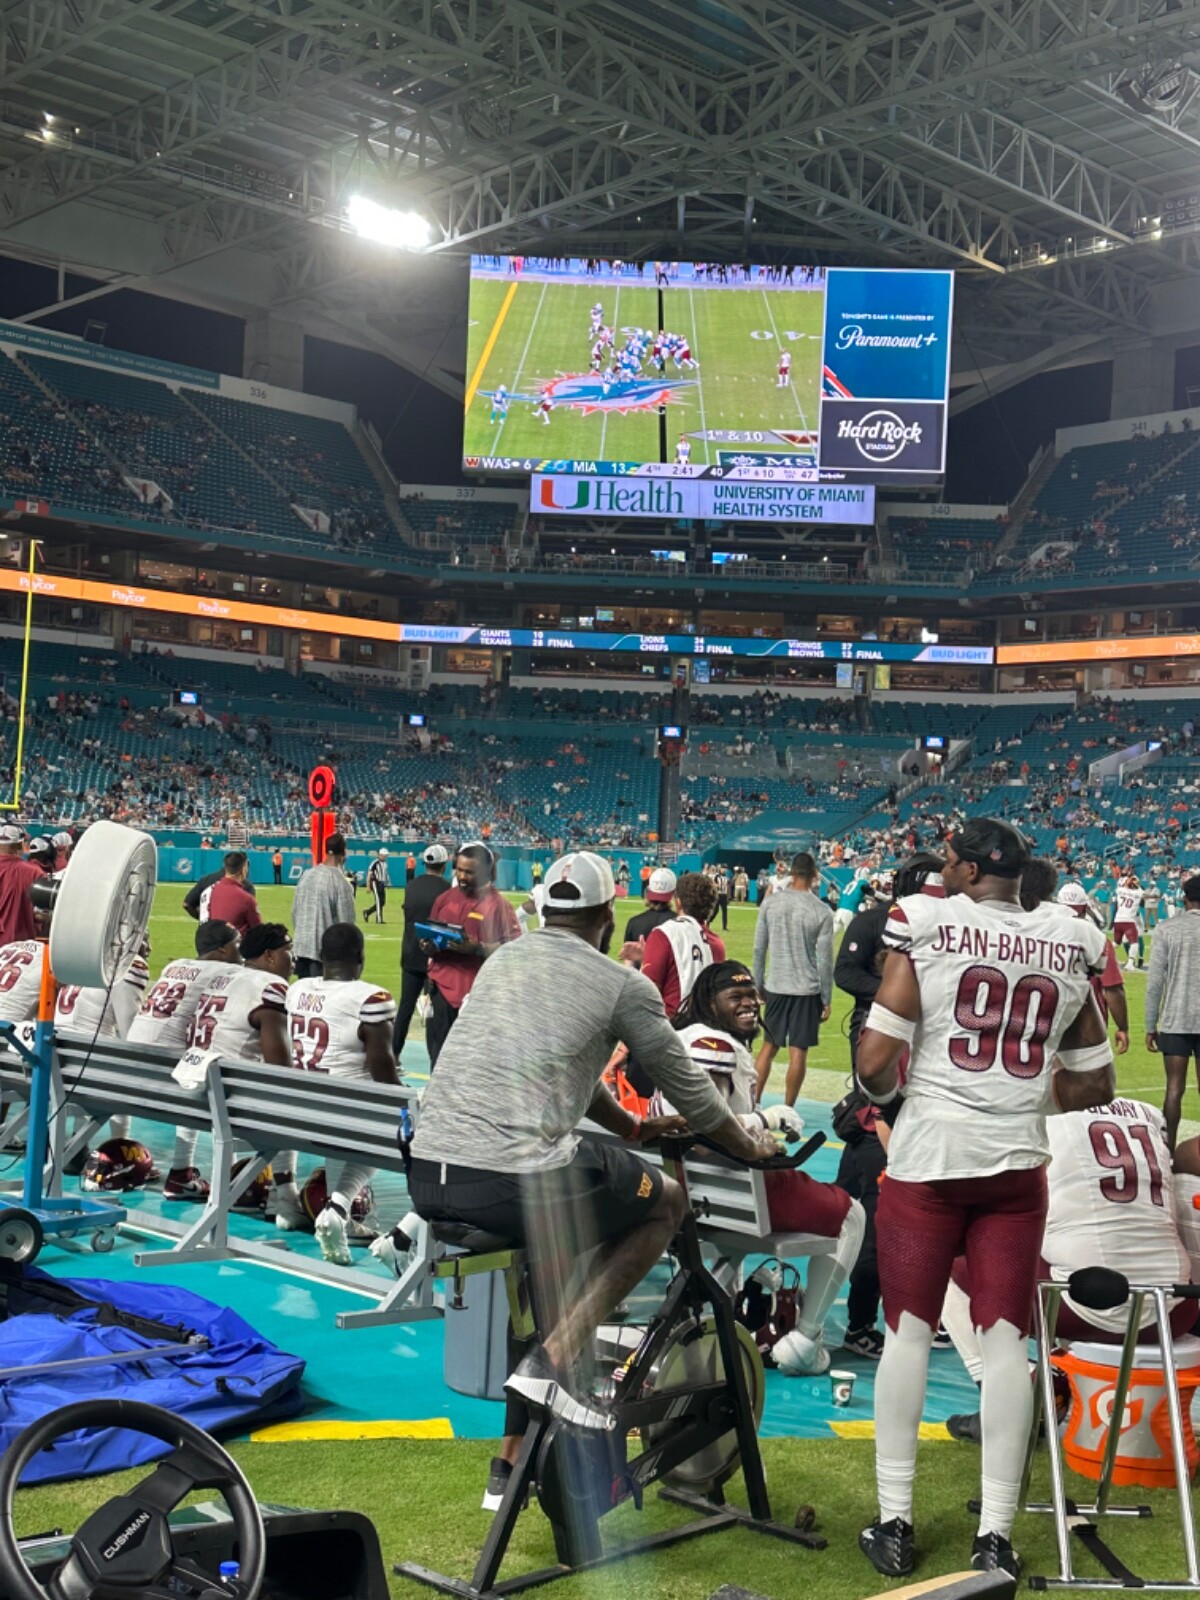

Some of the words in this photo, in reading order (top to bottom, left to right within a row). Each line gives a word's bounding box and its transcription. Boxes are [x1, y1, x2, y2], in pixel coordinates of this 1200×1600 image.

[835, 325, 938, 350] Paramount+
[250, 386, 267, 399] 336
[837, 420, 879, 438] Hard
[882, 421, 923, 443] Rock
[1131, 422, 1147, 433] 341
[727, 431, 742, 441] &
[744, 431, 763, 442] 10
[482, 458, 511, 469] WAS
[523, 459, 532, 470] 6
[573, 462, 598, 472] MIA
[611, 463, 626, 474] 13
[672, 466, 693, 476] 2:41
[710, 467, 723, 477] 40
[762, 469, 775, 479] 10
[801, 471, 813, 480] 47
[456, 487, 476, 498] 337
[714, 485, 794, 500] UNIVERSITY
[797, 488, 816, 501] OF
[818, 488, 865, 503] MIAMI
[713, 503, 764, 517] HEALTH
[769, 504, 823, 518] SYSTEM
[930, 505, 950, 515] 340
[112, 589, 146, 603] Paycor
[198, 601, 231, 615] Paycor
[404, 628, 427, 639] BUD
[428, 629, 460, 640] LIGHT
[480, 629, 510, 638] GIANTS
[640, 636, 666, 644] LIONS
[480, 638, 512, 646] TEXANS
[548, 639, 575, 648] FINAL
[640, 644, 669, 652] CHIEFS
[706, 645, 734, 654] FINAL
[788, 641, 822, 650] VIKINGS
[1095, 642, 1129, 655] Paycor
[788, 649, 825, 658] BROWNS
[856, 650, 884, 660] FINAL
[931, 649, 955, 659] BUD
[956, 650, 988, 660] LIGHT
[296, 992, 326, 1013] DAVIS
[949, 965, 1059, 1079] 90
[1088, 1120, 1164, 1207] 91
[103, 1511, 151, 1560] CUSHMAN
